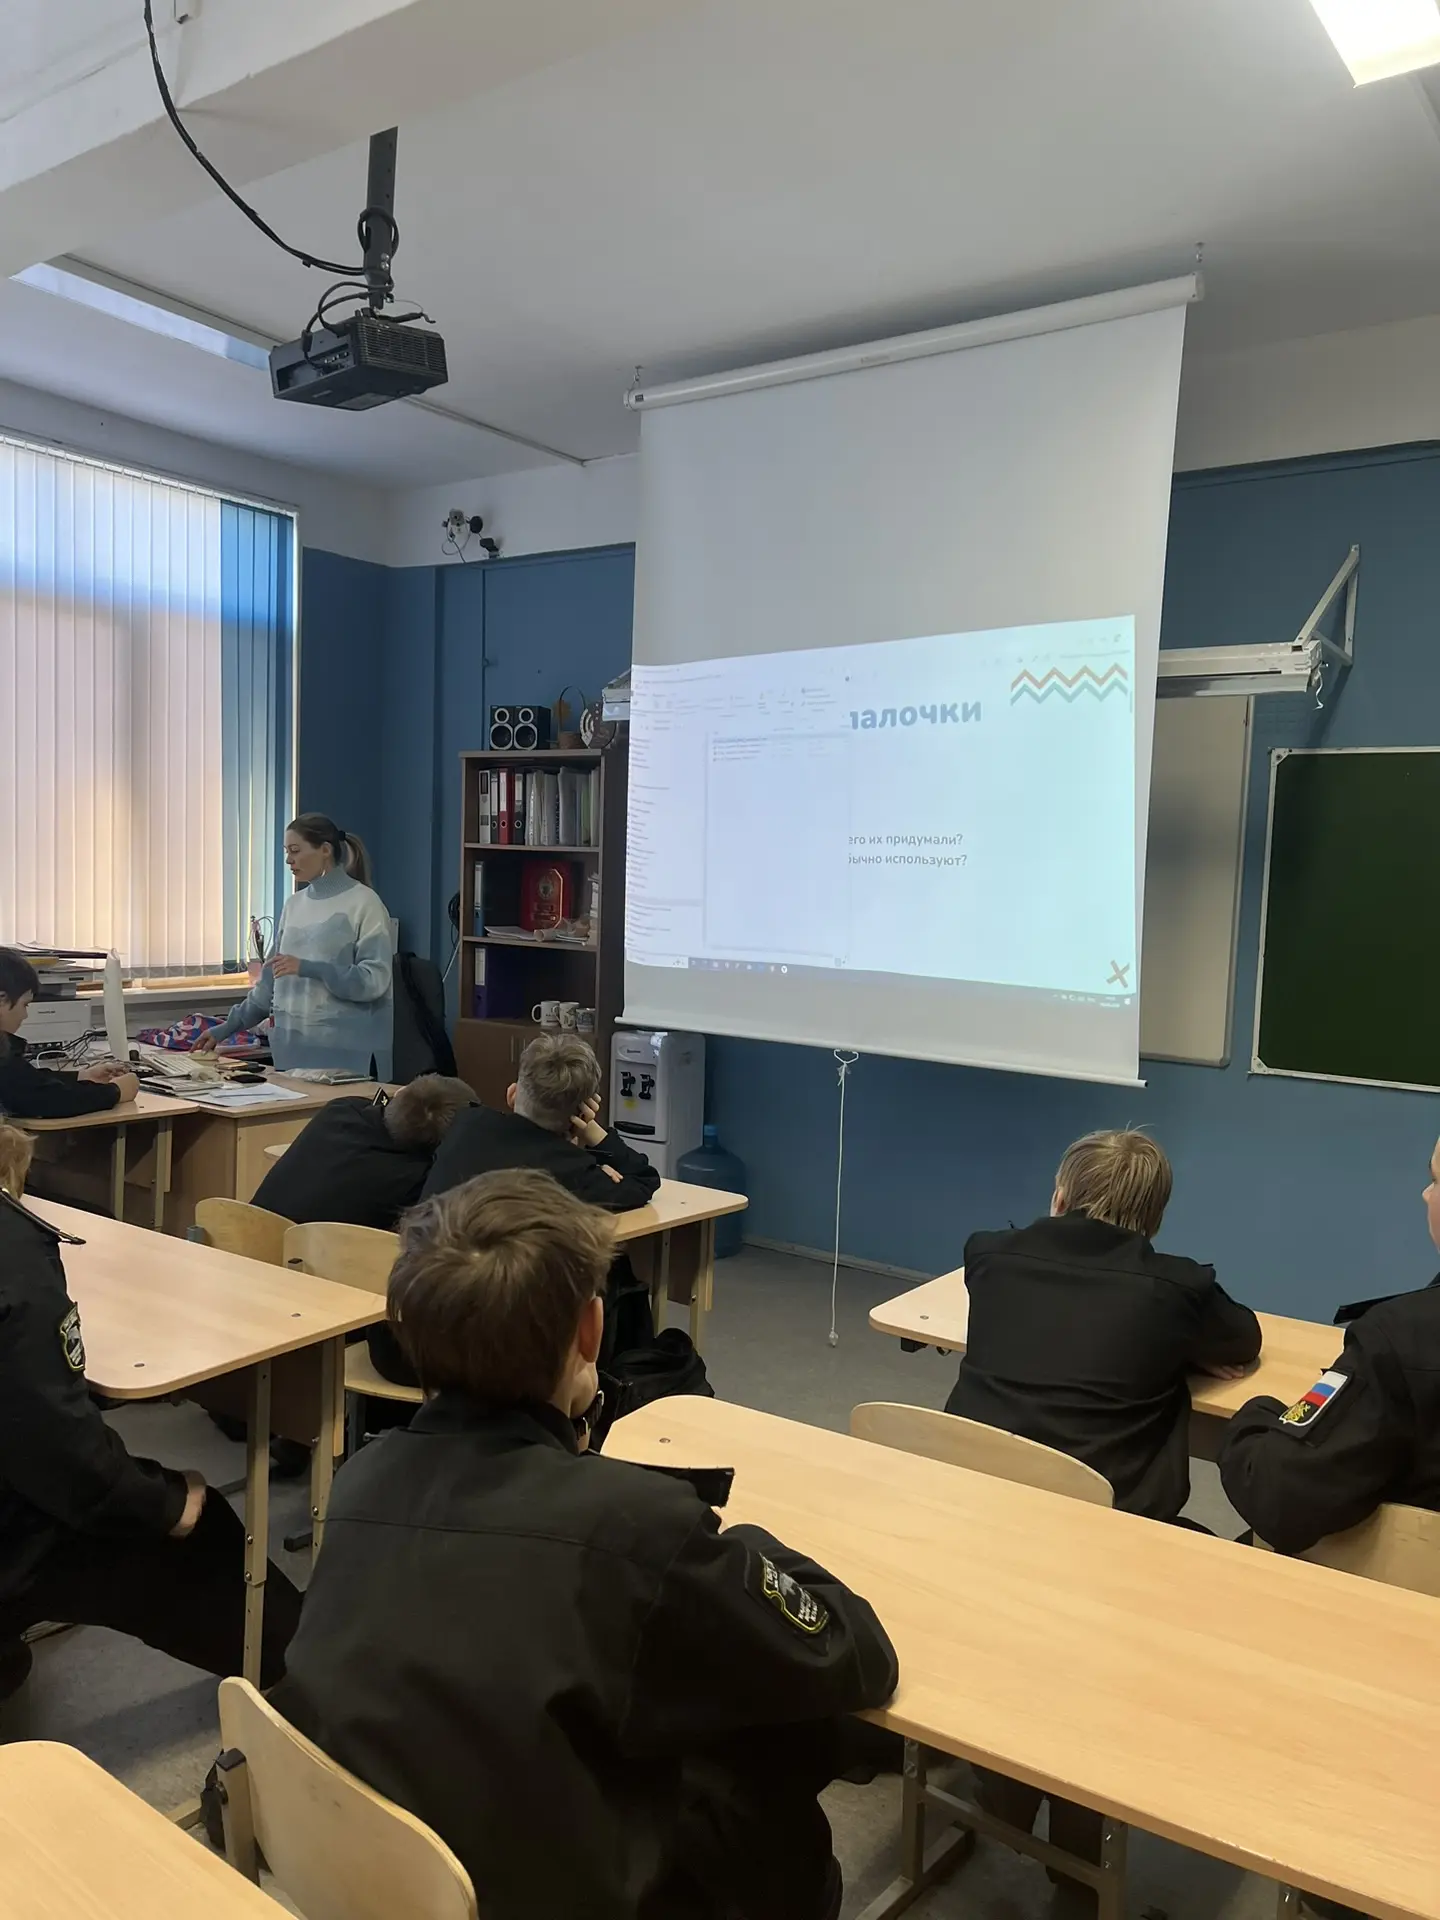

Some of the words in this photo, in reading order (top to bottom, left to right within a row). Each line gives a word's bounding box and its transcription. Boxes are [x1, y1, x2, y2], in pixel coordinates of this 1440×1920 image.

[869, 836, 883, 845] их
[886, 834, 963, 847] придумали?
[885, 855, 967, 867] используют?
